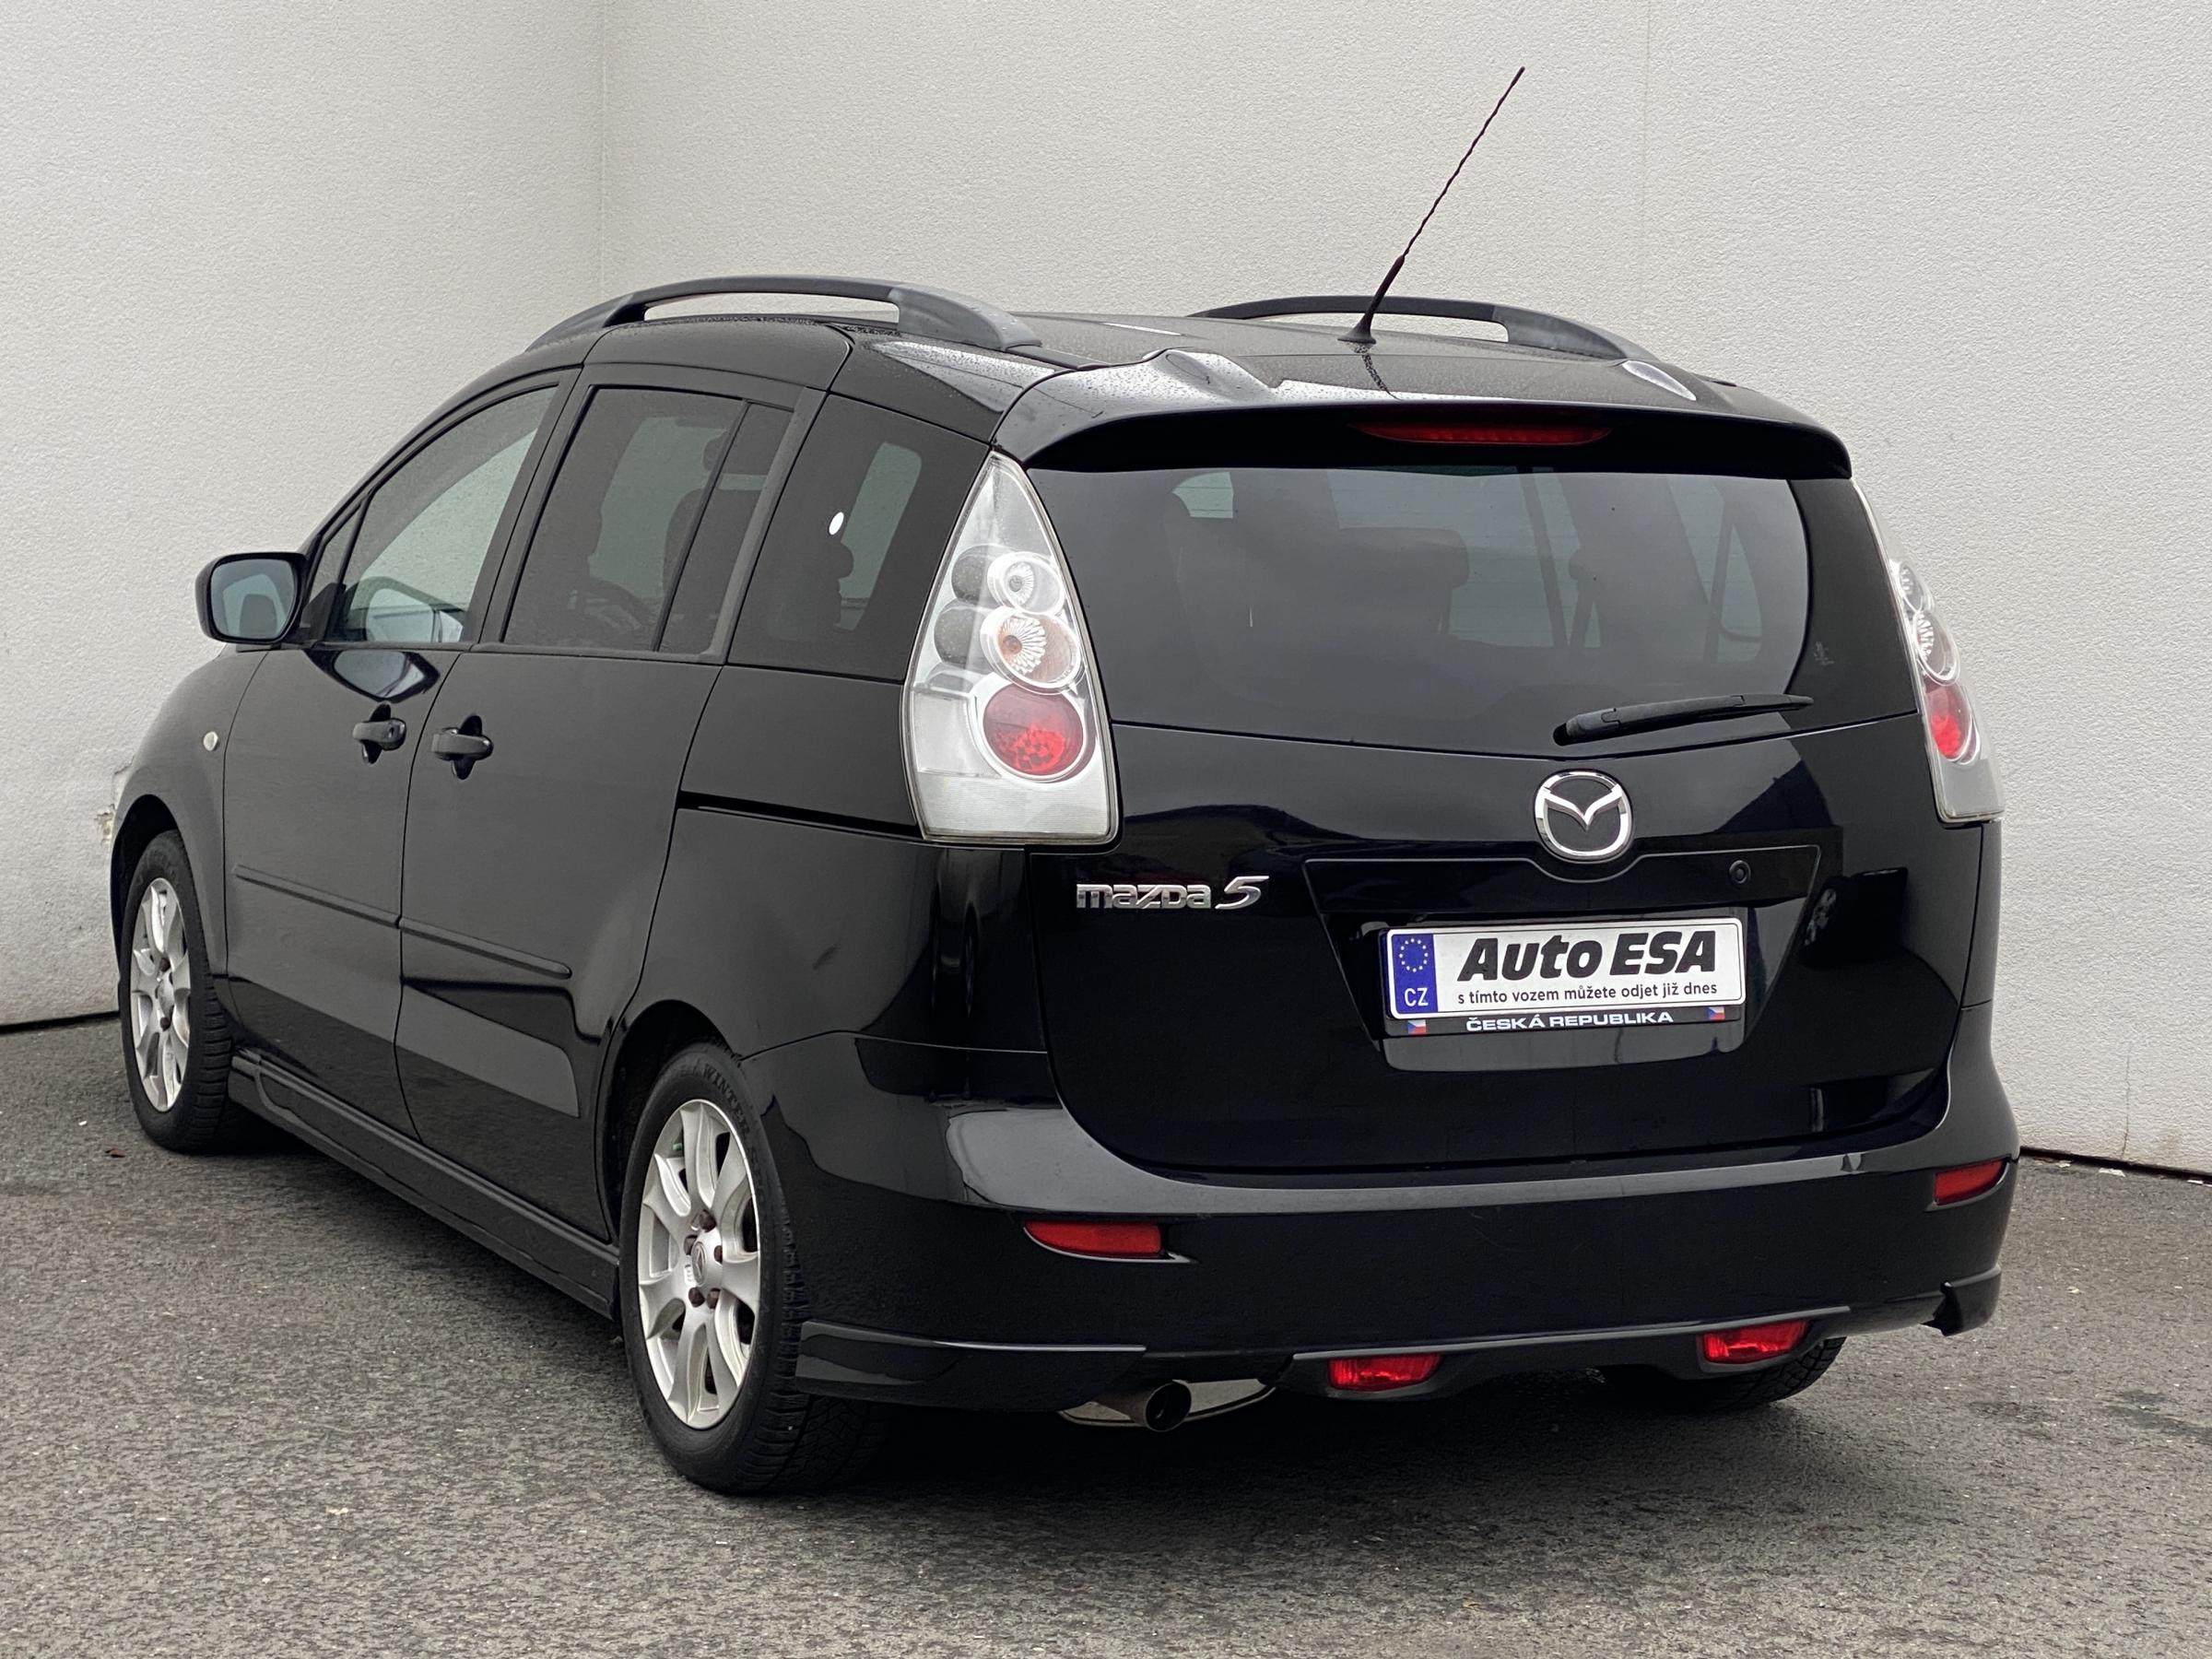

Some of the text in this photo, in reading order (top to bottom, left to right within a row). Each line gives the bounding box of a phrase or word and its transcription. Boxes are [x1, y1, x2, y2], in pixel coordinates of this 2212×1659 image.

[1214, 875, 1270, 910] 5
[1456, 930, 1717, 982] Auto ESA
[1404, 987, 1430, 1007] CZ
[1457, 981, 1718, 1006] s tímto vozem můžete odjet již dnes
[1465, 1011, 1674, 1032] ČESKÁ REPUBLIKA
